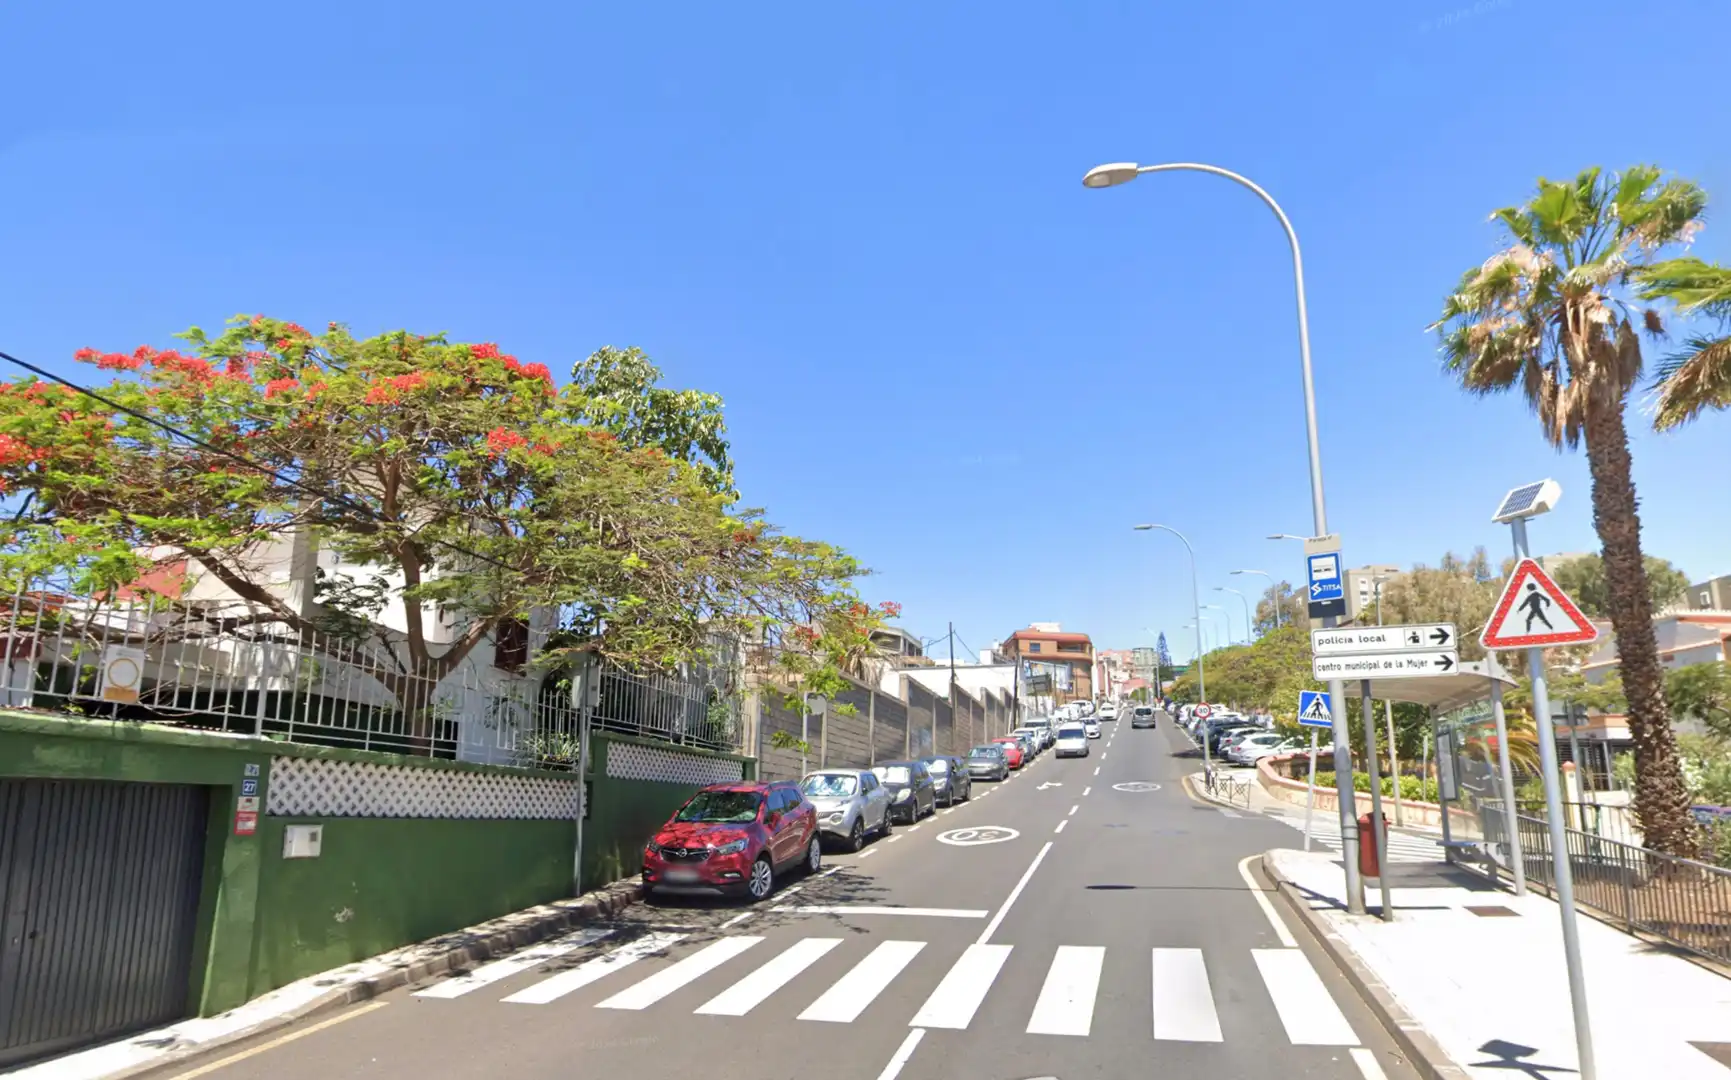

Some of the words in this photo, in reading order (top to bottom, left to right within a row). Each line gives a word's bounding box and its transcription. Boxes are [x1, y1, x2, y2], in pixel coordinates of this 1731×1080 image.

[1322, 583, 1341, 592] TITSA
[1358, 633, 1386, 643] local
[1317, 662, 1341, 671] centro
[1345, 659, 1380, 671] municipal
[1383, 660, 1392, 669] de
[1395, 659, 1403, 668] la
[1406, 658, 1428, 669] Mujer
